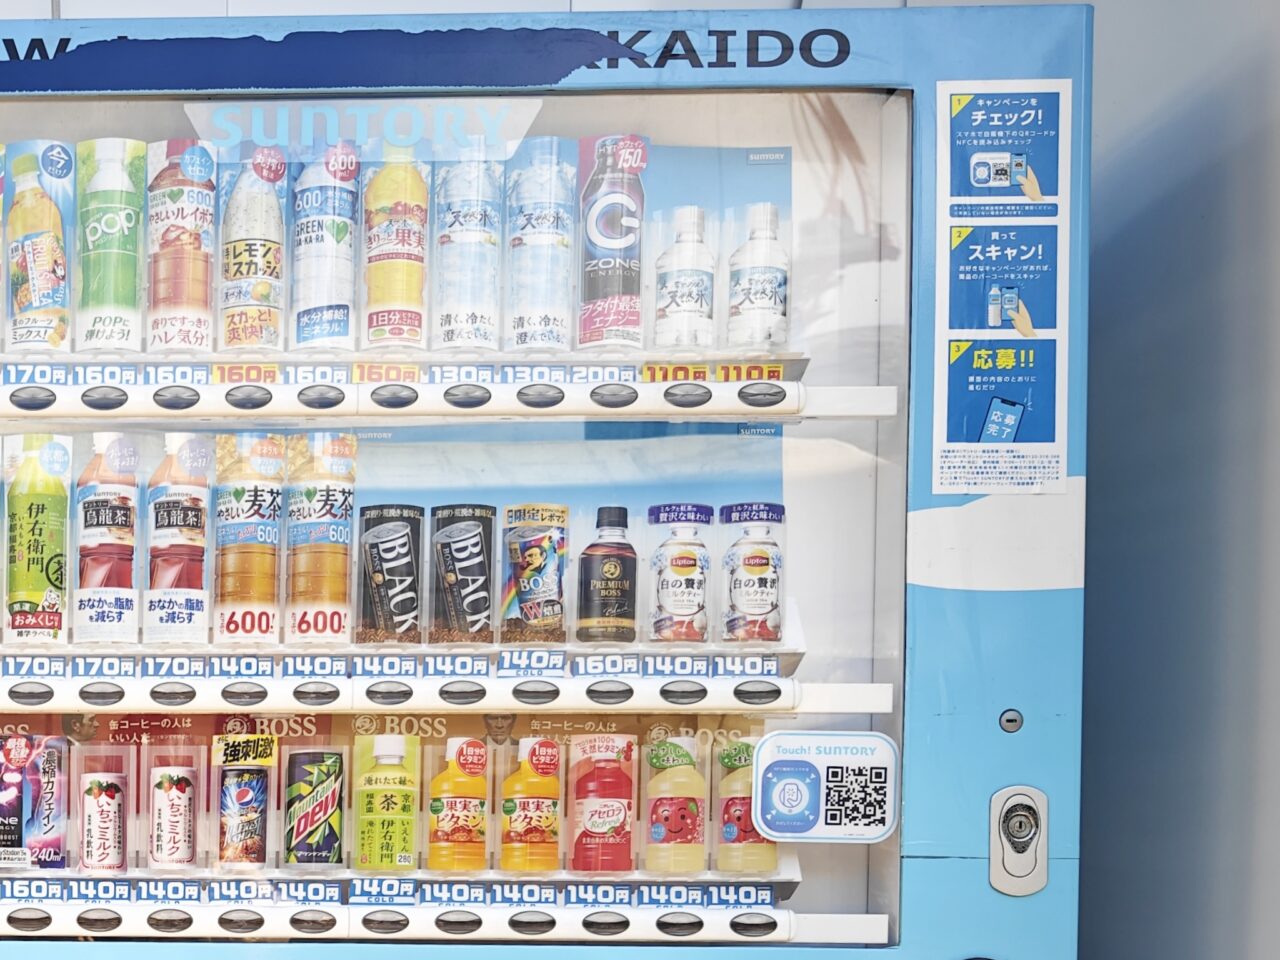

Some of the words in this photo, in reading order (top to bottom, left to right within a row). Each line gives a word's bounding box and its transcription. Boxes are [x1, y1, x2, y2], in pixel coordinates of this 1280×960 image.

[584, 29, 851, 68] KAIDO
[976, 98, 1038, 107] キャンペーンを
[210, 103, 511, 149] SUNTORY
[971, 109, 1043, 126] チェック!
[329, 155, 356, 171] 600
[749, 152, 785, 160] SUNTORY
[991, 232, 1017, 240] 買って
[233, 243, 271, 259] レモン
[969, 244, 1043, 261] スキャン!
[233, 259, 281, 280] スカッシュ
[92, 318, 130, 328] POPに
[151, 316, 209, 330] 香りですっきり
[226, 310, 272, 327] スカッと!
[12, 329, 48, 341] ミックス!
[150, 329, 209, 347] ハレ気分!
[228, 325, 264, 341] 爽快!
[301, 323, 344, 338] ミネラル!
[972, 349, 1035, 369] 応募!!
[8, 365, 67, 384] 170円
[74, 365, 135, 384] 160円
[147, 365, 207, 384] 160円
[217, 365, 277, 384] 160円
[286, 366, 347, 384] 160円
[357, 364, 419, 383] 160円
[432, 366, 494, 384] 130円
[505, 366, 566, 383] 130円
[572, 366, 636, 383] 200円
[647, 365, 708, 382] 110円
[721, 364, 781, 382] 110円
[741, 428, 776, 436] SUNTORY
[245, 485, 282, 520] 麦茶
[316, 485, 354, 520] 麦茶
[85, 509, 127, 526] 烏龍茶
[156, 509, 198, 526] 烏龍茶
[26, 501, 46, 573] 伊右衛門
[672, 557, 696, 568] Lipton
[744, 557, 768, 568] Lipton
[379, 534, 418, 633] BLACK
[451, 534, 490, 633] BLACK
[519, 574, 558, 593] BOSS
[590, 579, 630, 591] PREMIUM
[79, 598, 134, 612] おなかの脂肪
[150, 598, 205, 612] おなかの脂肪
[89, 612, 124, 624] を減らす
[160, 612, 195, 624] を減らす
[5, 657, 64, 675] 170円
[76, 657, 134, 675] 170円
[145, 657, 204, 675] 170円
[211, 657, 270, 675] 140円
[285, 657, 345, 675] 140円
[353, 657, 415, 675] 140円
[425, 657, 486, 675] 140円
[502, 651, 566, 669] 140円
[576, 656, 639, 674] 160円
[645, 658, 708, 675] 140円
[715, 657, 777, 675] 140円
[108, 718, 192, 731] 缶コーヒーの人は
[255, 716, 316, 737] BOSS
[384, 715, 447, 737] BOSS
[530, 720, 617, 732] 缶コーヒーの人は
[223, 739, 274, 764] 強刺激
[776, 745, 812, 756] Touch!
[815, 745, 877, 757] SUNTORY
[42, 751, 57, 836] 濃縮カフェイン
[288, 780, 334, 826] Mountain
[294, 783, 340, 841] DEW
[380, 794, 398, 812] 茶
[588, 808, 622, 821] アセロラ
[97, 801, 111, 863] いちごミルク
[167, 793, 180, 857] いちごミルク
[380, 819, 394, 864] 伊右衛門
[2, 880, 62, 898] 160円
[69, 882, 129, 899] 140円
[138, 882, 199, 899] 140円
[209, 882, 271, 900] 140円
[278, 883, 340, 901] 140円
[352, 879, 415, 896] 140円
[422, 884, 484, 901] 140円
[491, 884, 554, 902] 140円
[567, 885, 630, 902] 140円
[639, 886, 701, 903] 140円
[710, 886, 772, 904] 140円
